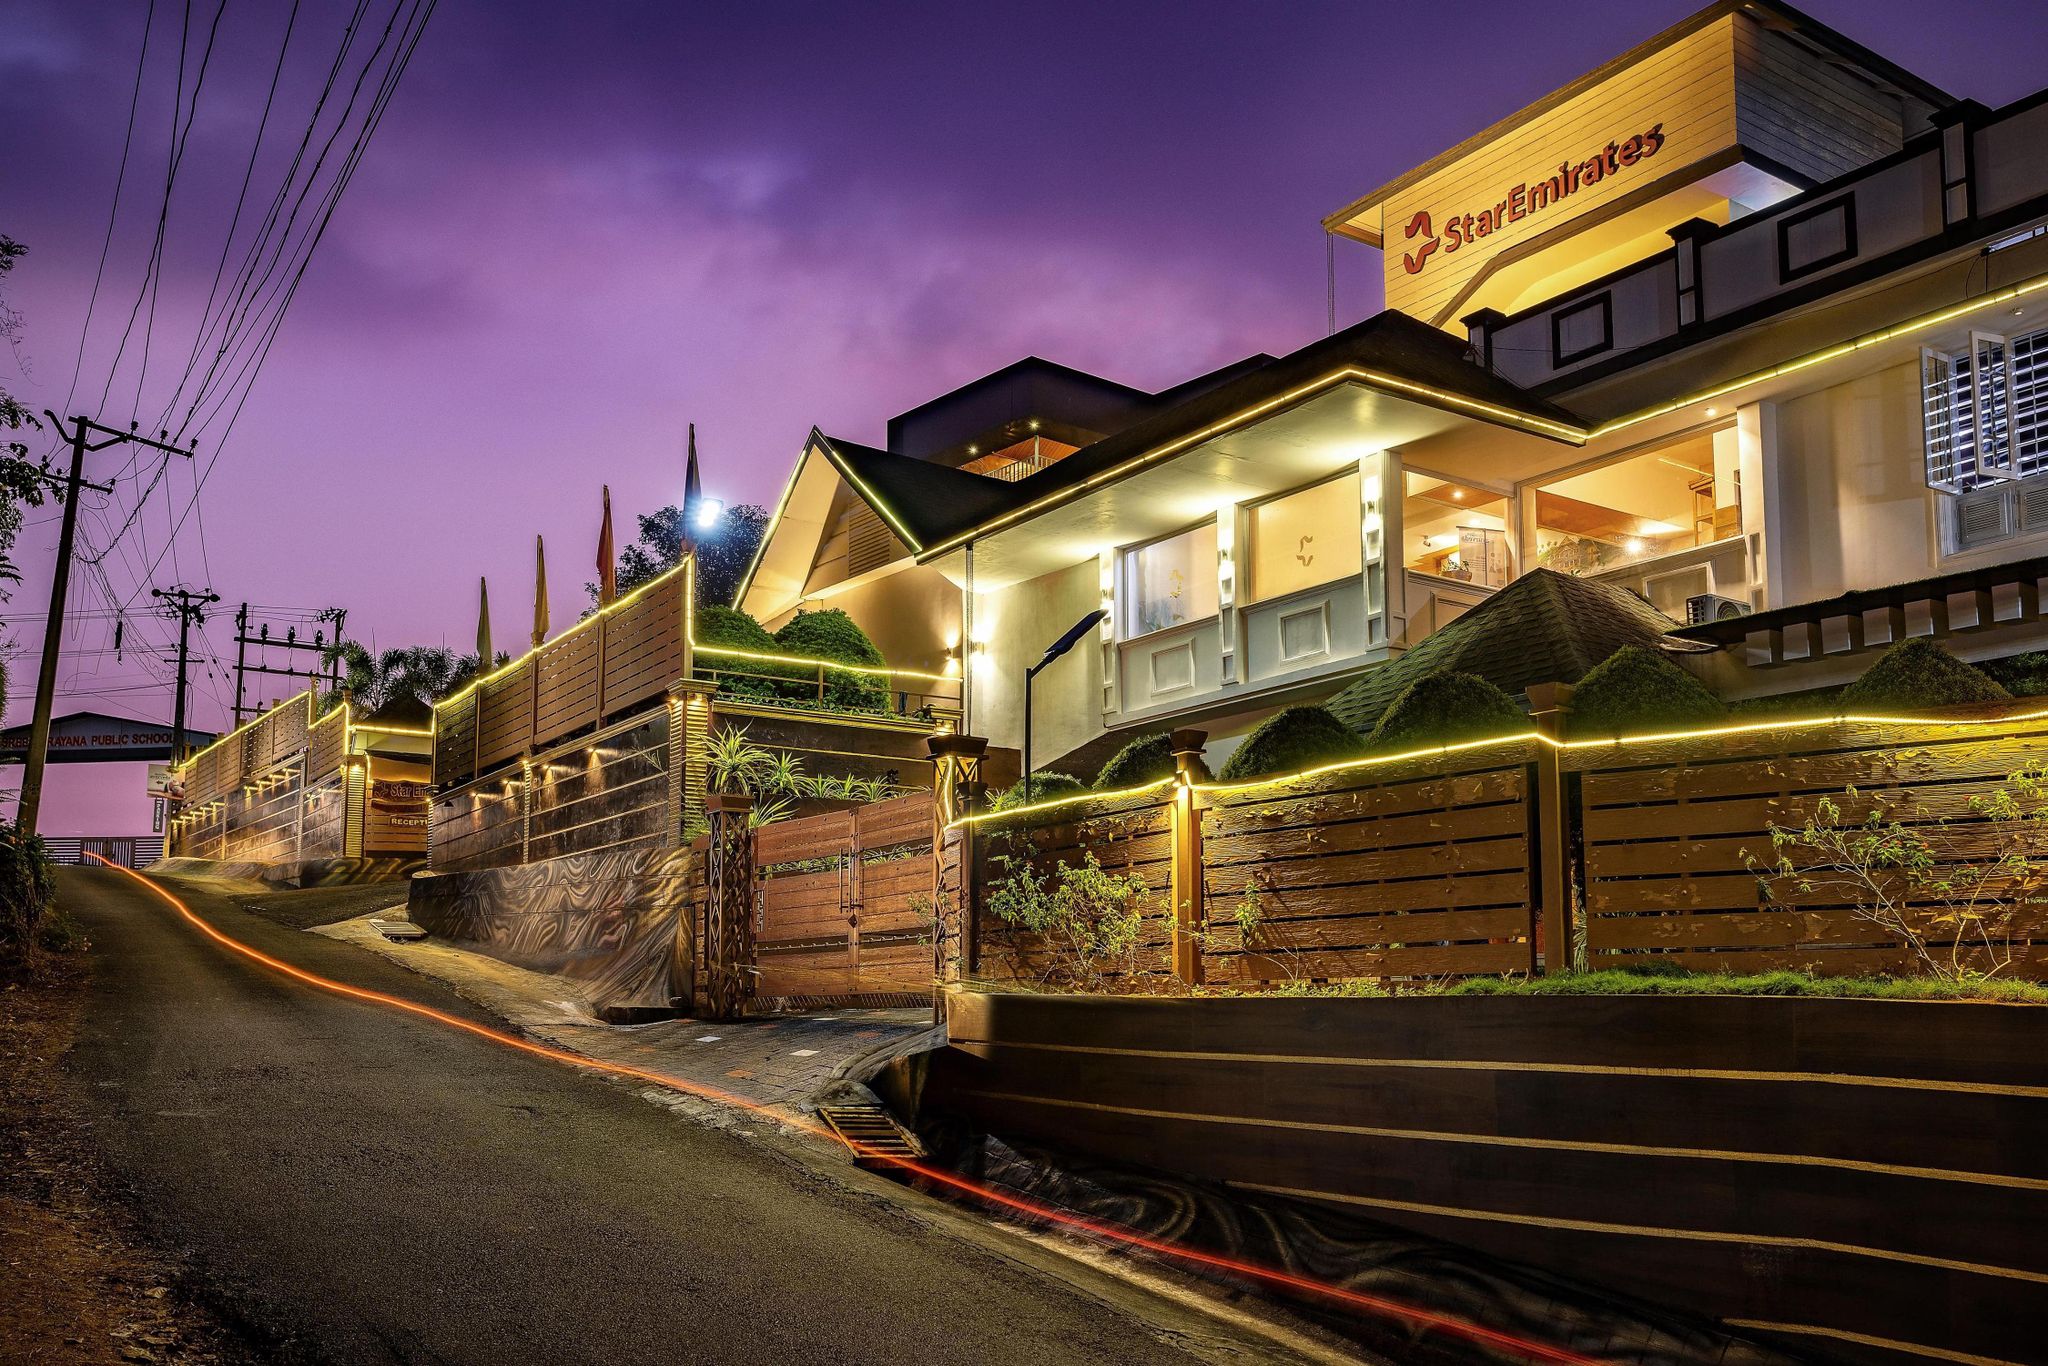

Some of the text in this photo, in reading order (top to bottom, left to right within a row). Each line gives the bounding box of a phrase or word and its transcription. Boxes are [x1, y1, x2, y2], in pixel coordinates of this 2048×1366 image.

[1444, 124, 1664, 253] StarEmirates
[48, 735, 87, 747] RAYANA
[91, 734, 129, 746] PUBLIC
[131, 732, 174, 745] SCHOOL
[390, 784, 411, 797] Star
